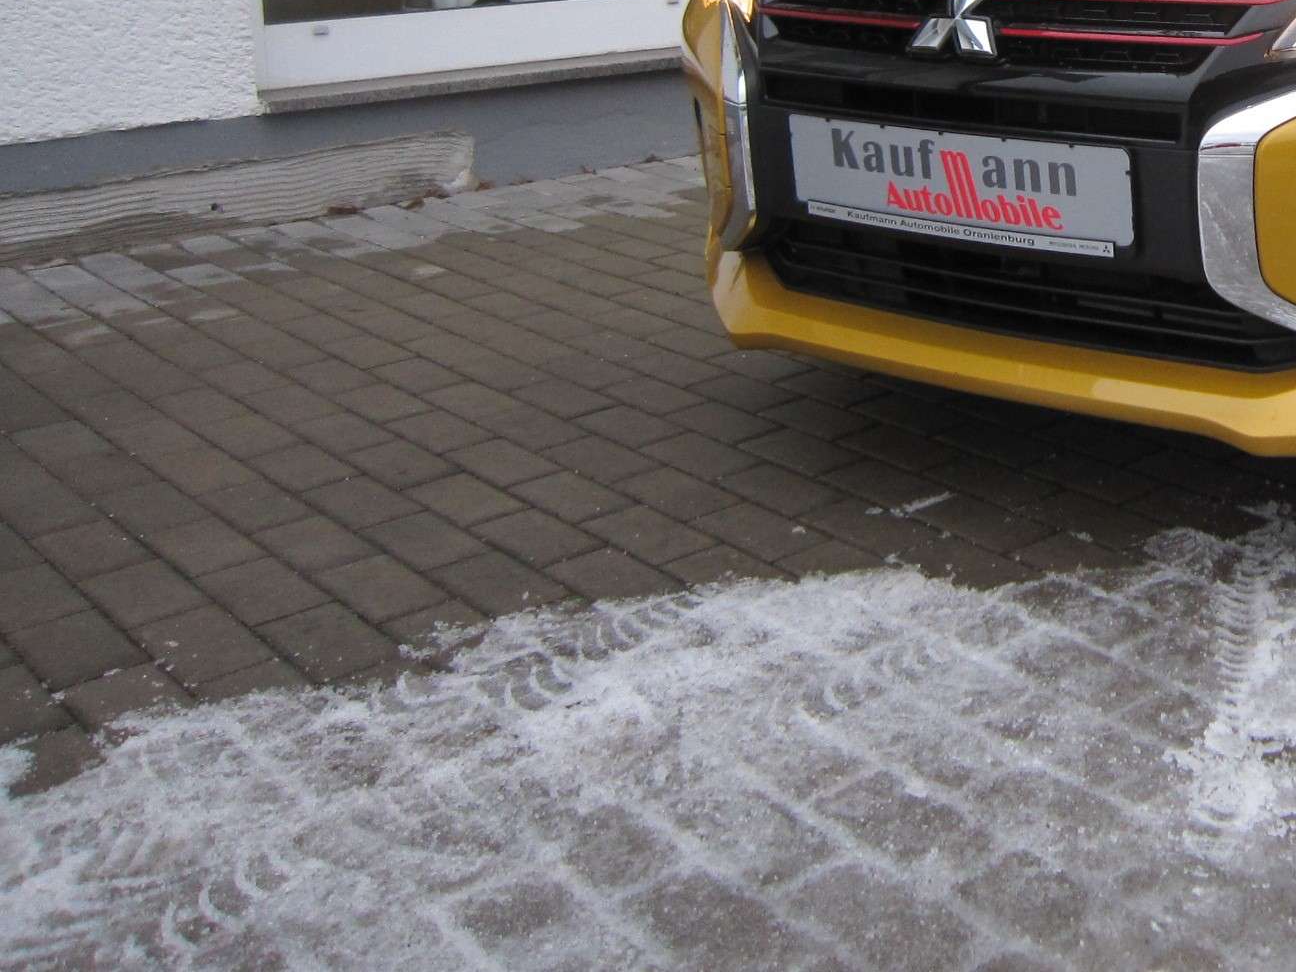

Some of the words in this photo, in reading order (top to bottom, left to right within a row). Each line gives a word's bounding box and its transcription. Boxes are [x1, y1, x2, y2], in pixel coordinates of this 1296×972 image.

[847, 210, 898, 226] Kaufmann
[900, 218, 960, 235] Automobile
[962, 227, 1036, 247] Oranienburg
